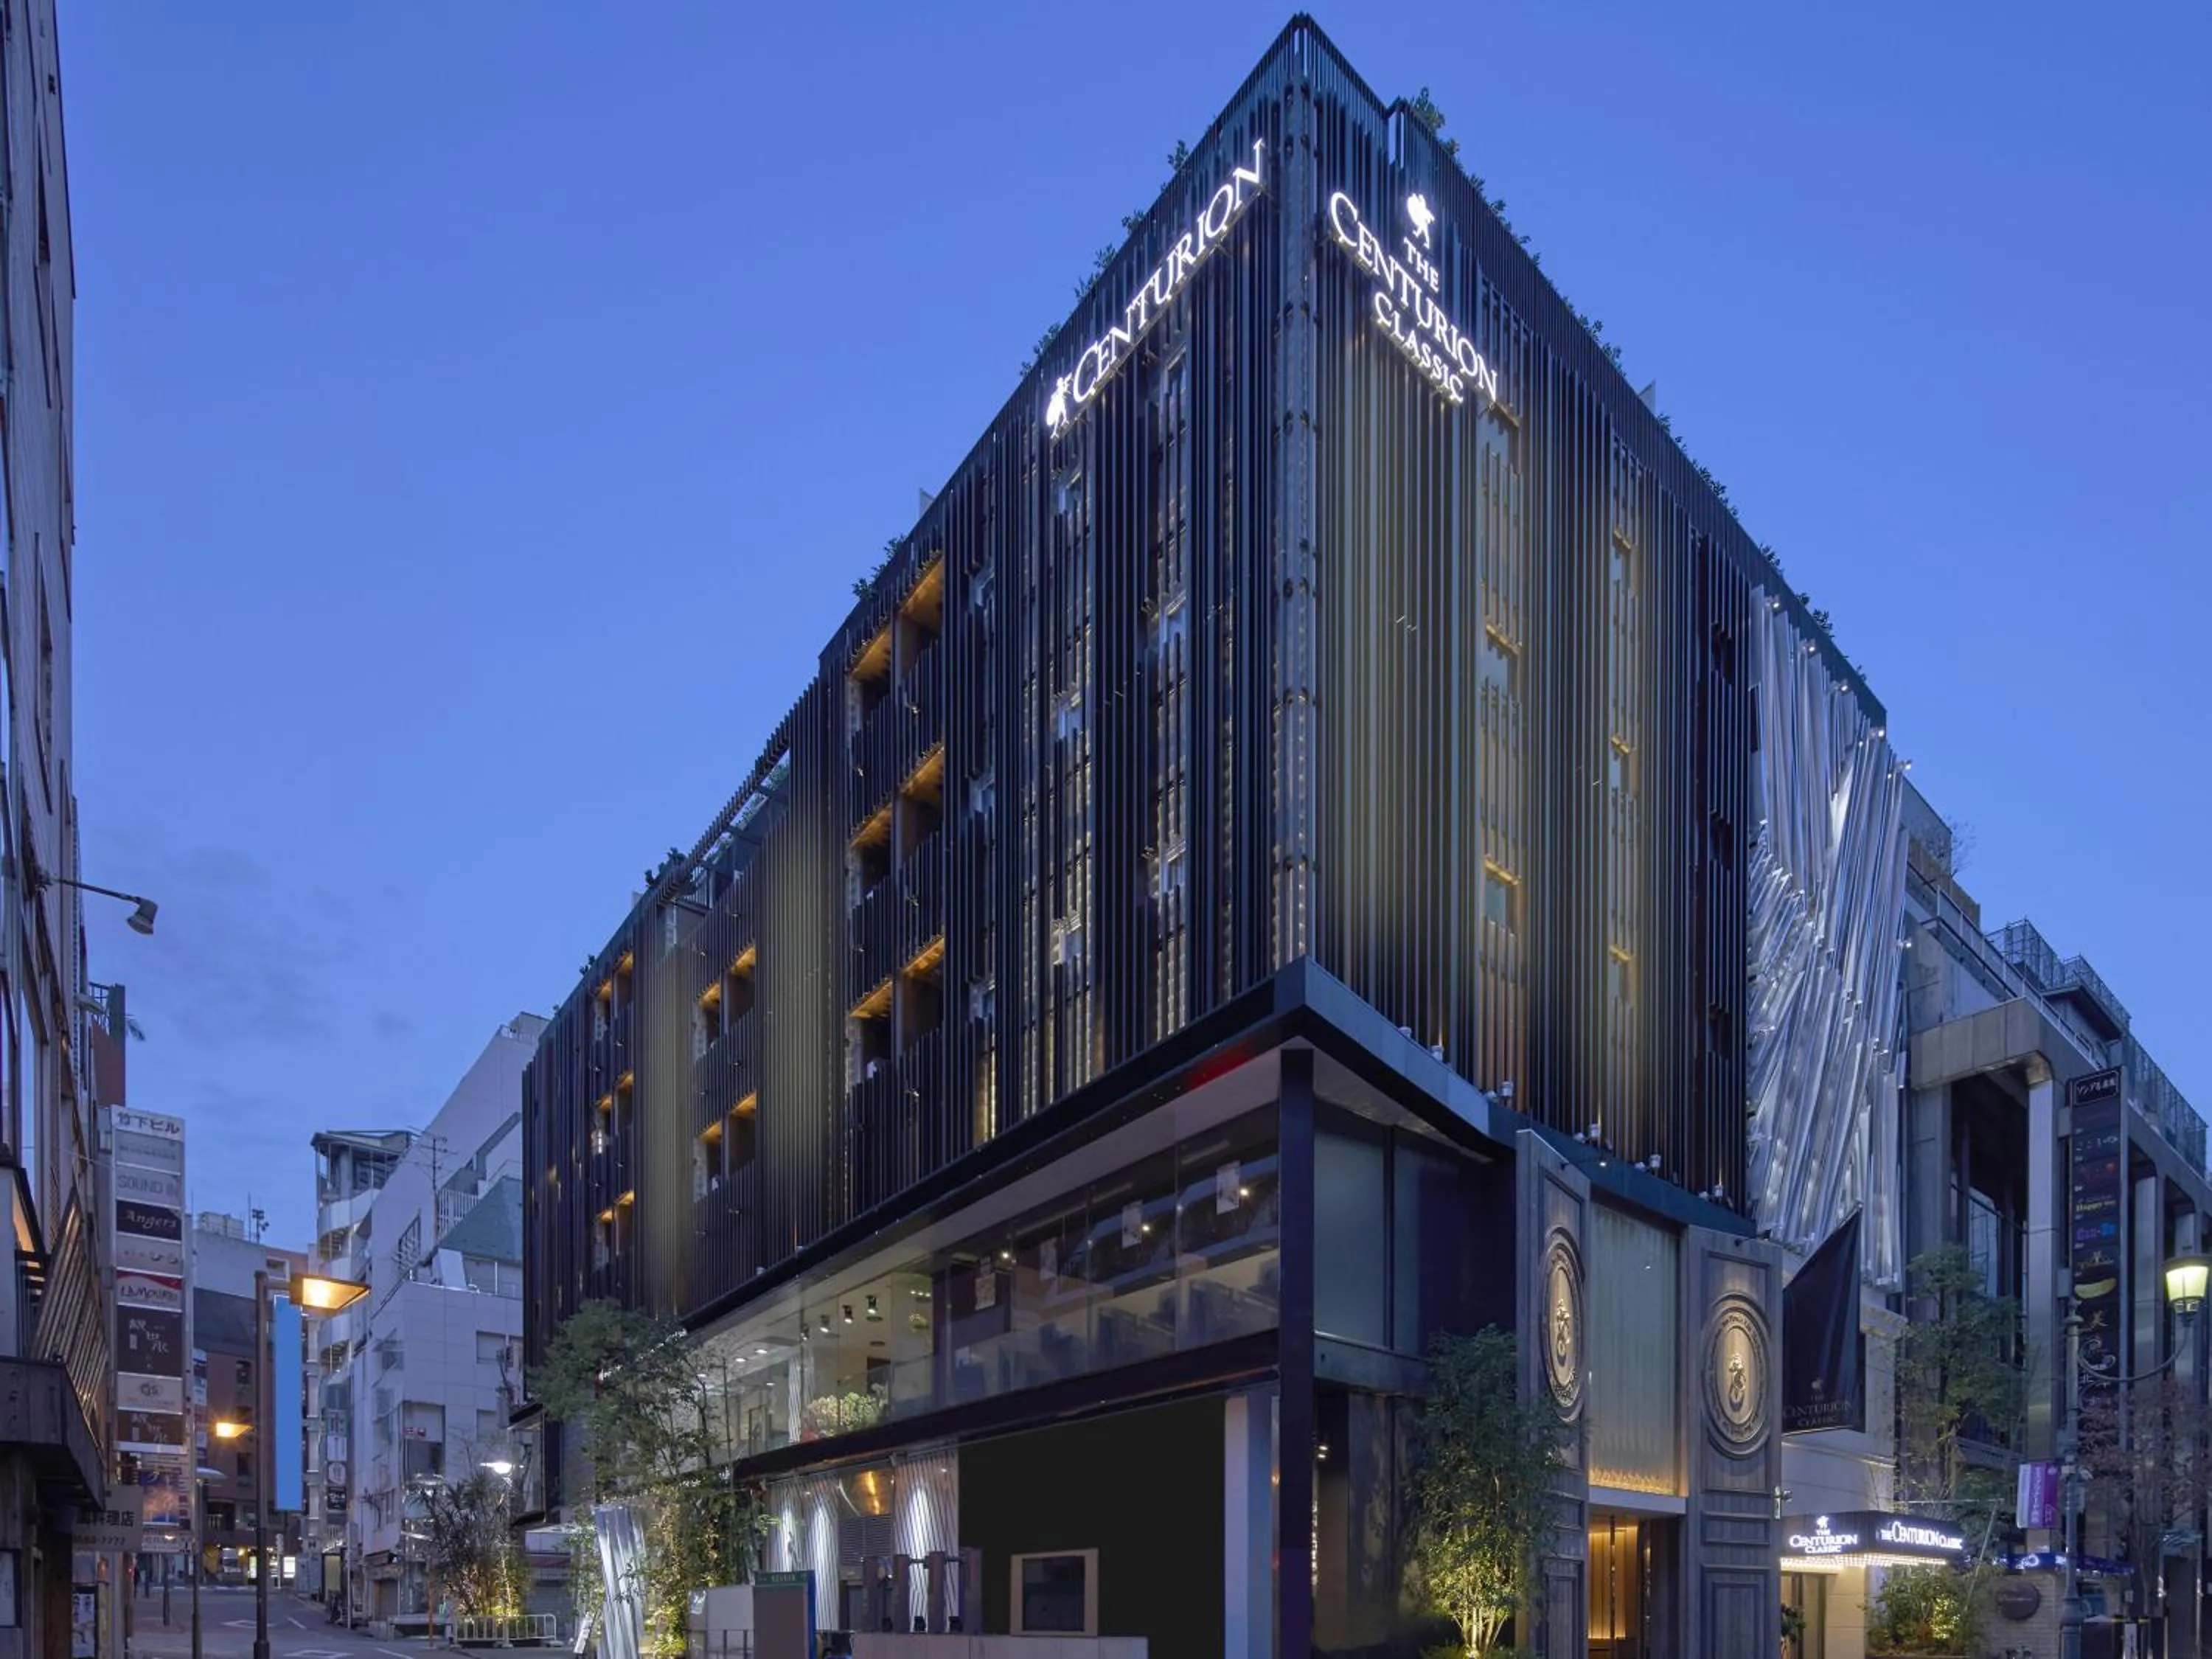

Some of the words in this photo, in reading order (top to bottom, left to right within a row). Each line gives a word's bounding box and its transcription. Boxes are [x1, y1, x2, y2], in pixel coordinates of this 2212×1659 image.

[1072, 138, 1265, 403] CENTURION
[1330, 191, 1498, 403] CENTURION
[1403, 237, 1439, 293] THE
[1374, 291, 1464, 403] CLASSIC
[1789, 1534, 1859, 1548] CENTURION
[1892, 1520, 1939, 1546] CENTURION
